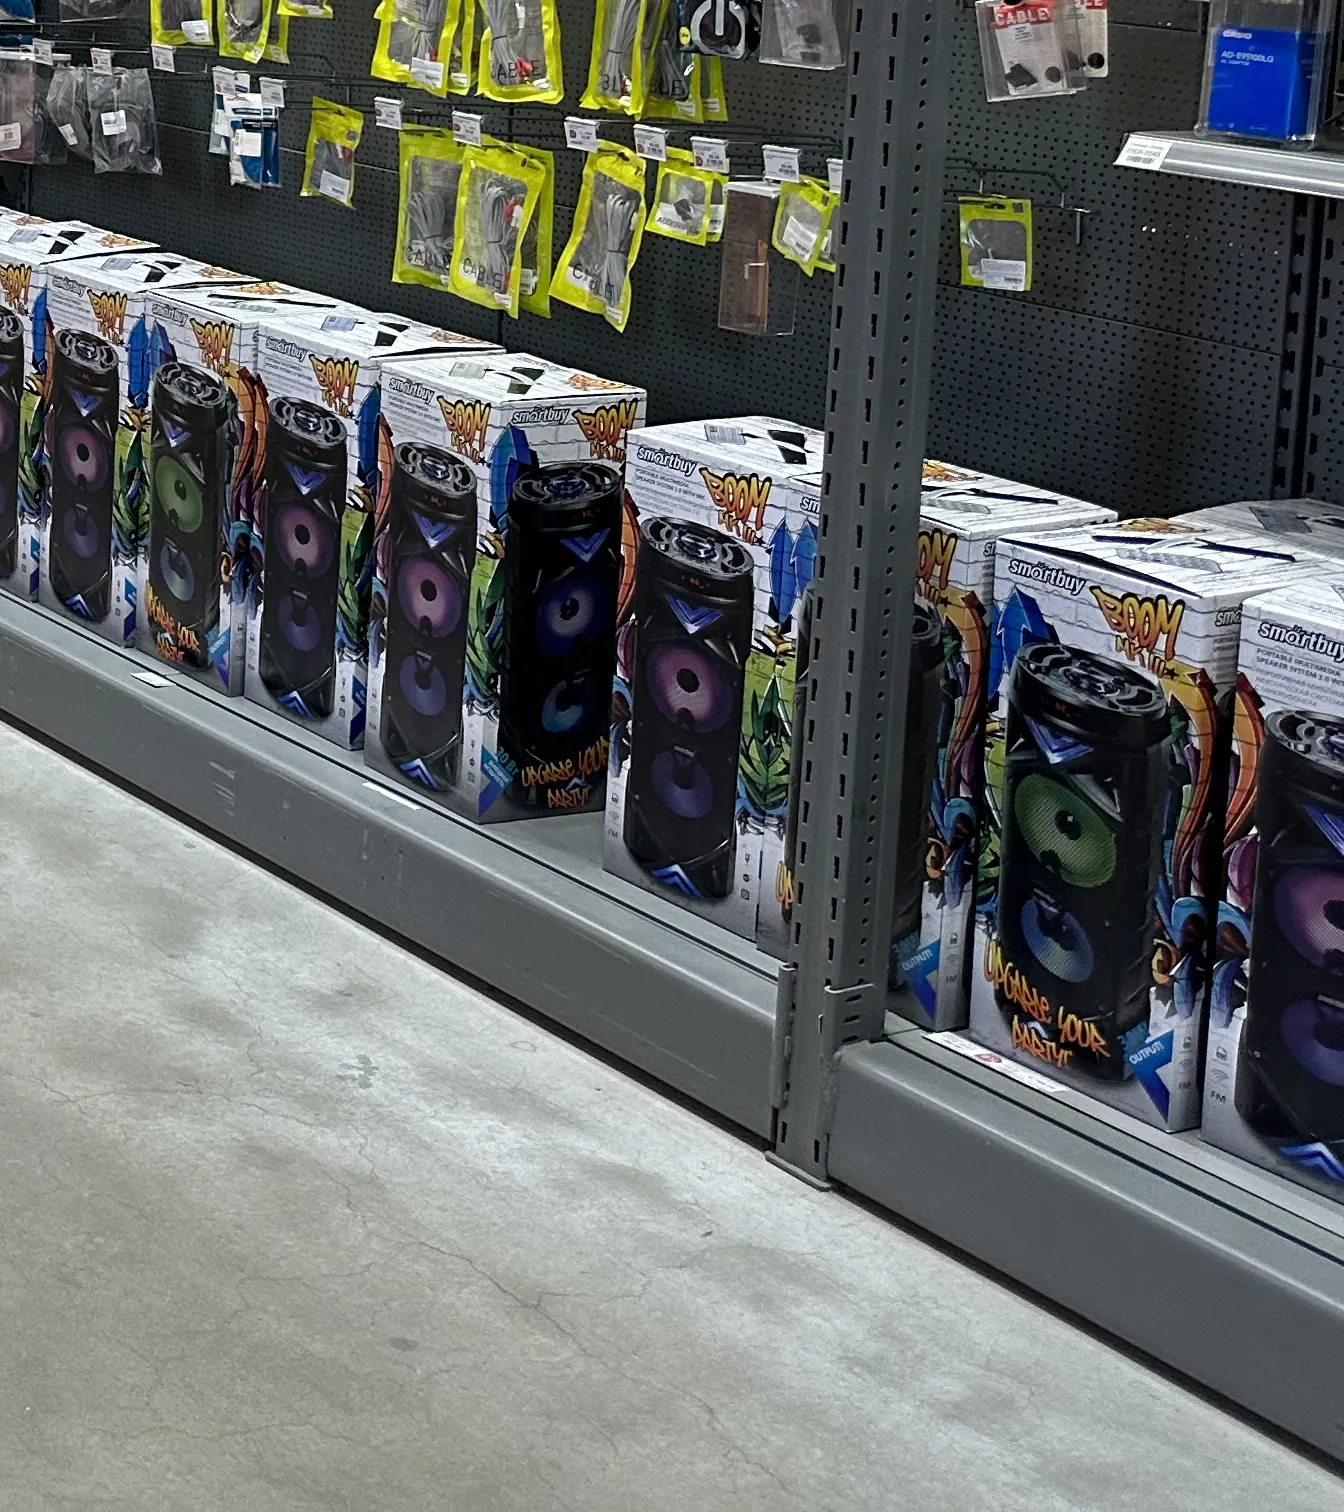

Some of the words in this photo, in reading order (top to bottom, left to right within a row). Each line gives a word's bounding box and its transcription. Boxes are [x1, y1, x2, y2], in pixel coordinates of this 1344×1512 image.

[309, 353, 359, 407] BOOM
[388, 376, 435, 404] smartbuy
[436, 395, 492, 452] BOOM
[511, 405, 570, 425] smartbuy
[571, 398, 639, 446] BOOM
[637, 446, 697, 477] smartbuy
[699, 467, 772, 531] BOOM
[1009, 558, 1087, 595] smartbuy
[1090, 585, 1185, 661] BOOM
[1259, 621, 1344, 662] smartbuy
